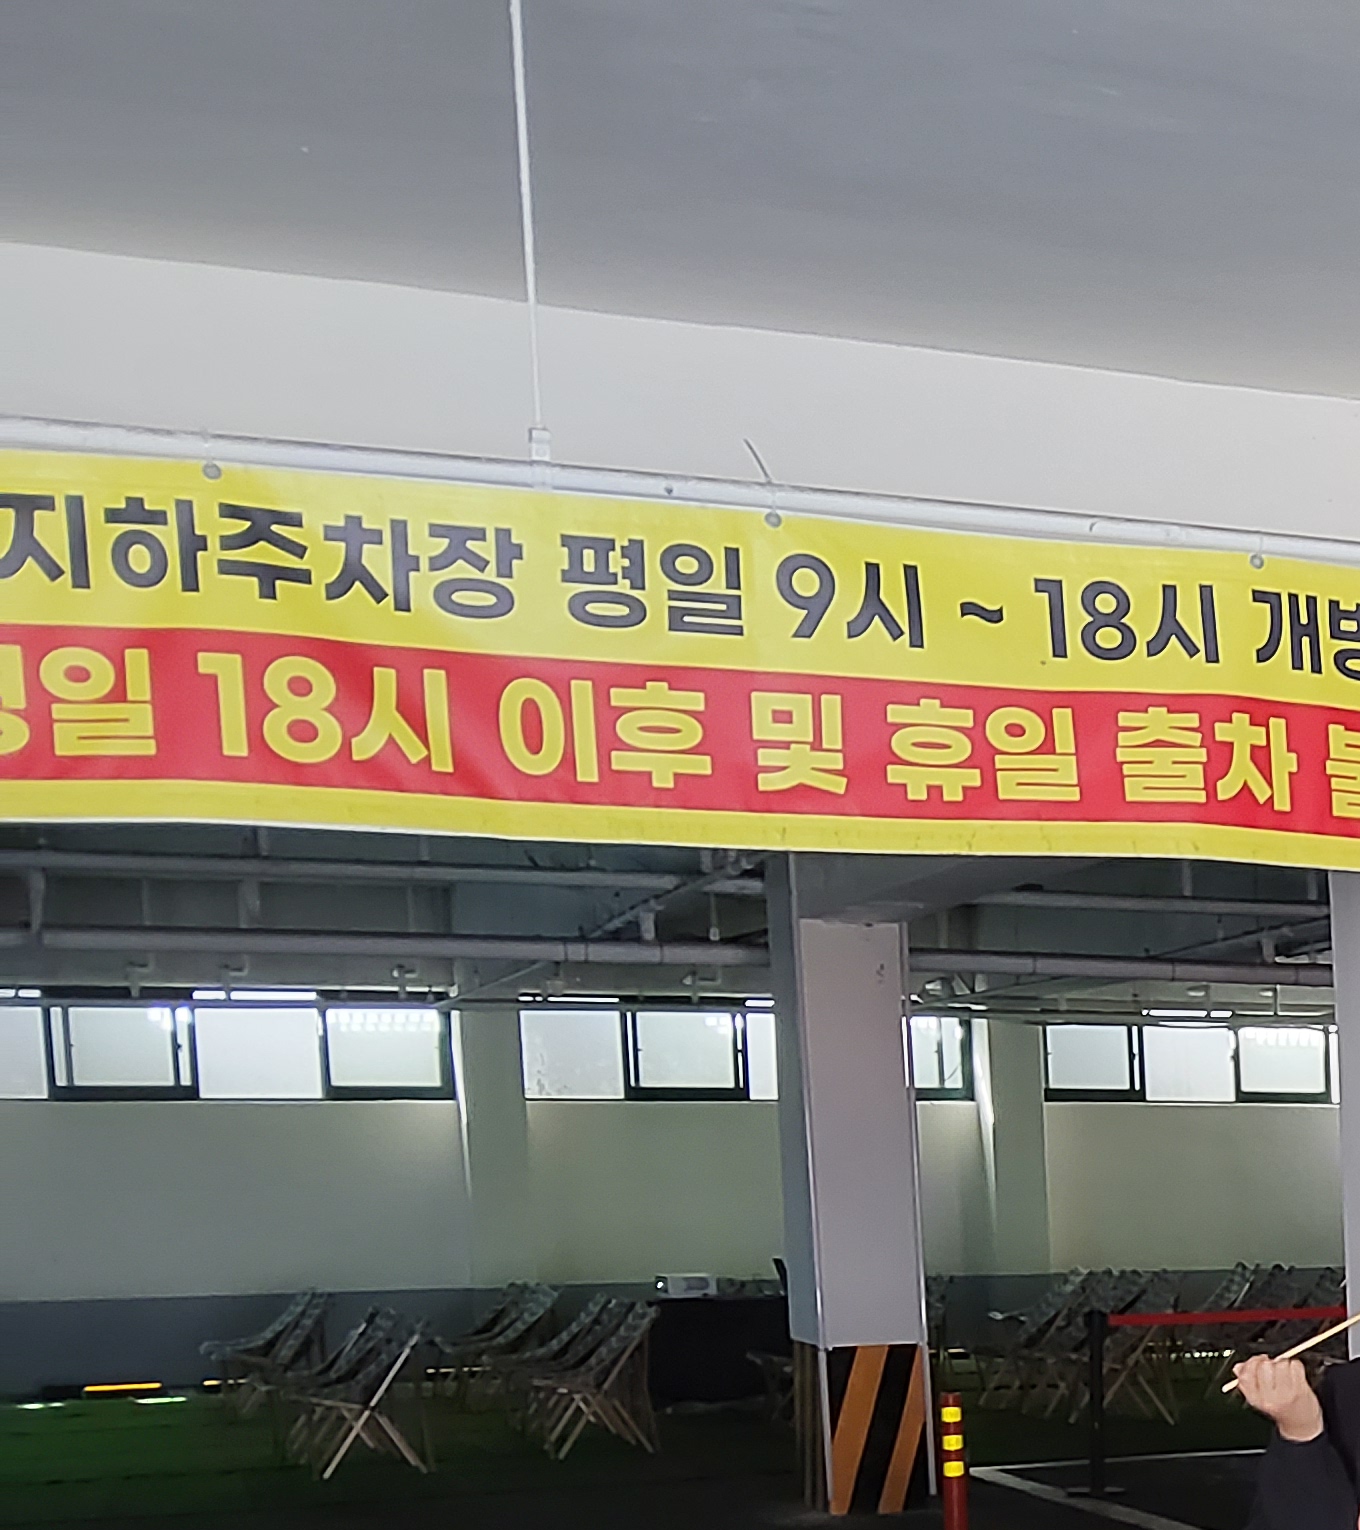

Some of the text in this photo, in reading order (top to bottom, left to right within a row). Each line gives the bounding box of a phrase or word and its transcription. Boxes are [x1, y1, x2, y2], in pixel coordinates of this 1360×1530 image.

[0, 493, 524, 619] 지하주차장
[560, 533, 744, 637] 평일
[776, 552, 926, 650] 9시
[1033, 578, 1220, 665] 18시
[198, 651, 455, 773] 18시
[498, 676, 713, 789] 이후
[750, 690, 848, 794] 및
[886, 697, 1080, 802] 휴일
[1115, 705, 1298, 812] 출차
